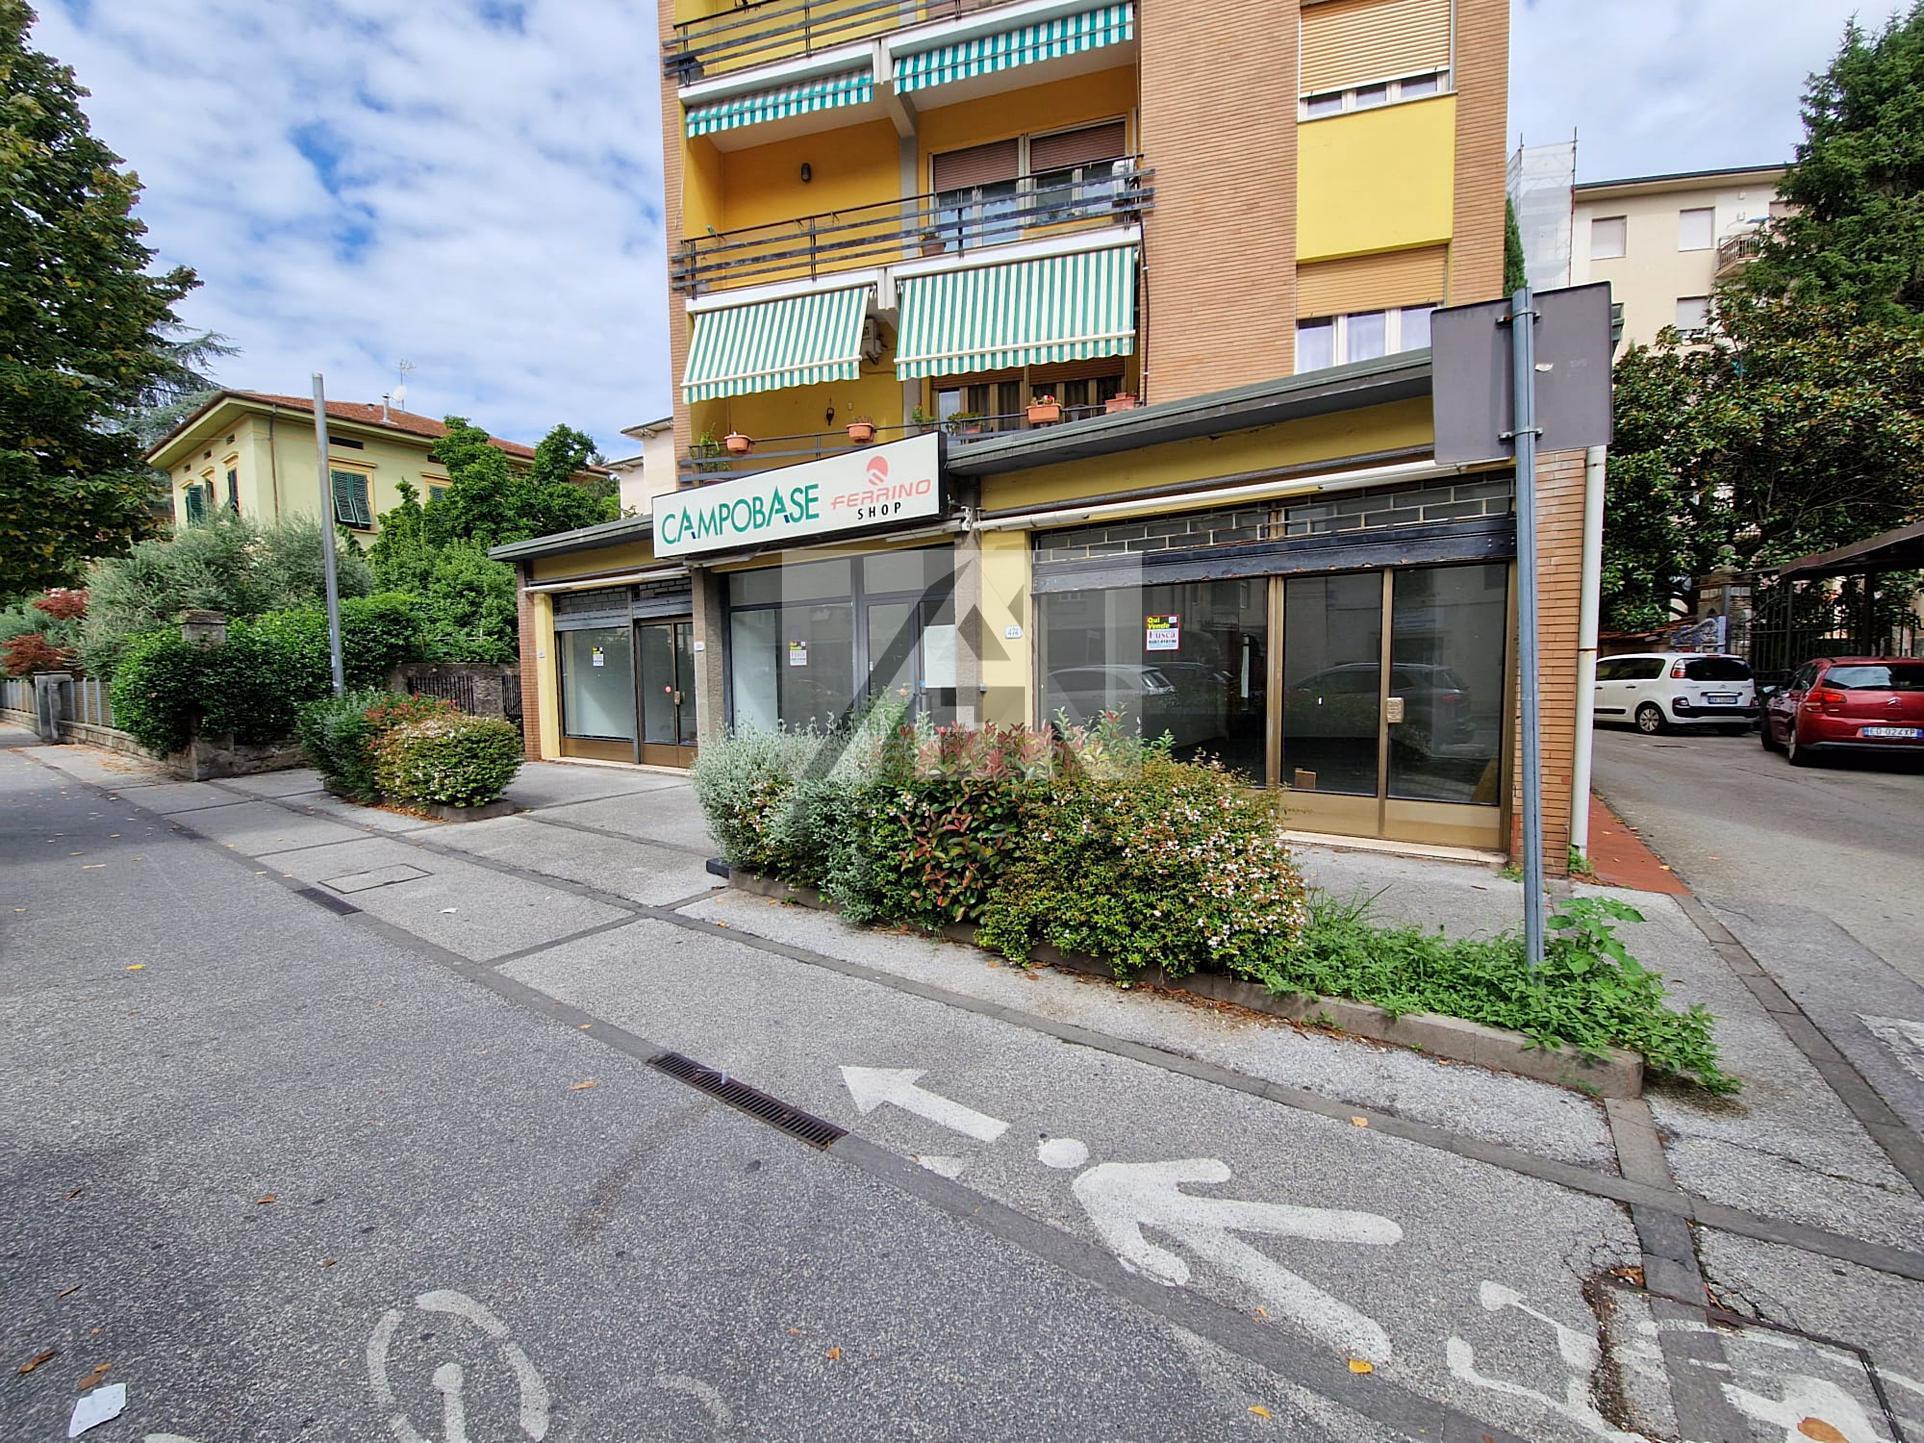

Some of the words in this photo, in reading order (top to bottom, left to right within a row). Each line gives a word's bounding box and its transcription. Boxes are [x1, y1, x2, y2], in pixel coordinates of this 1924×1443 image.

[831, 479, 931, 510] FERRINO
[661, 484, 820, 545] CAMPOBASE
[857, 501, 902, 520] SHOP
